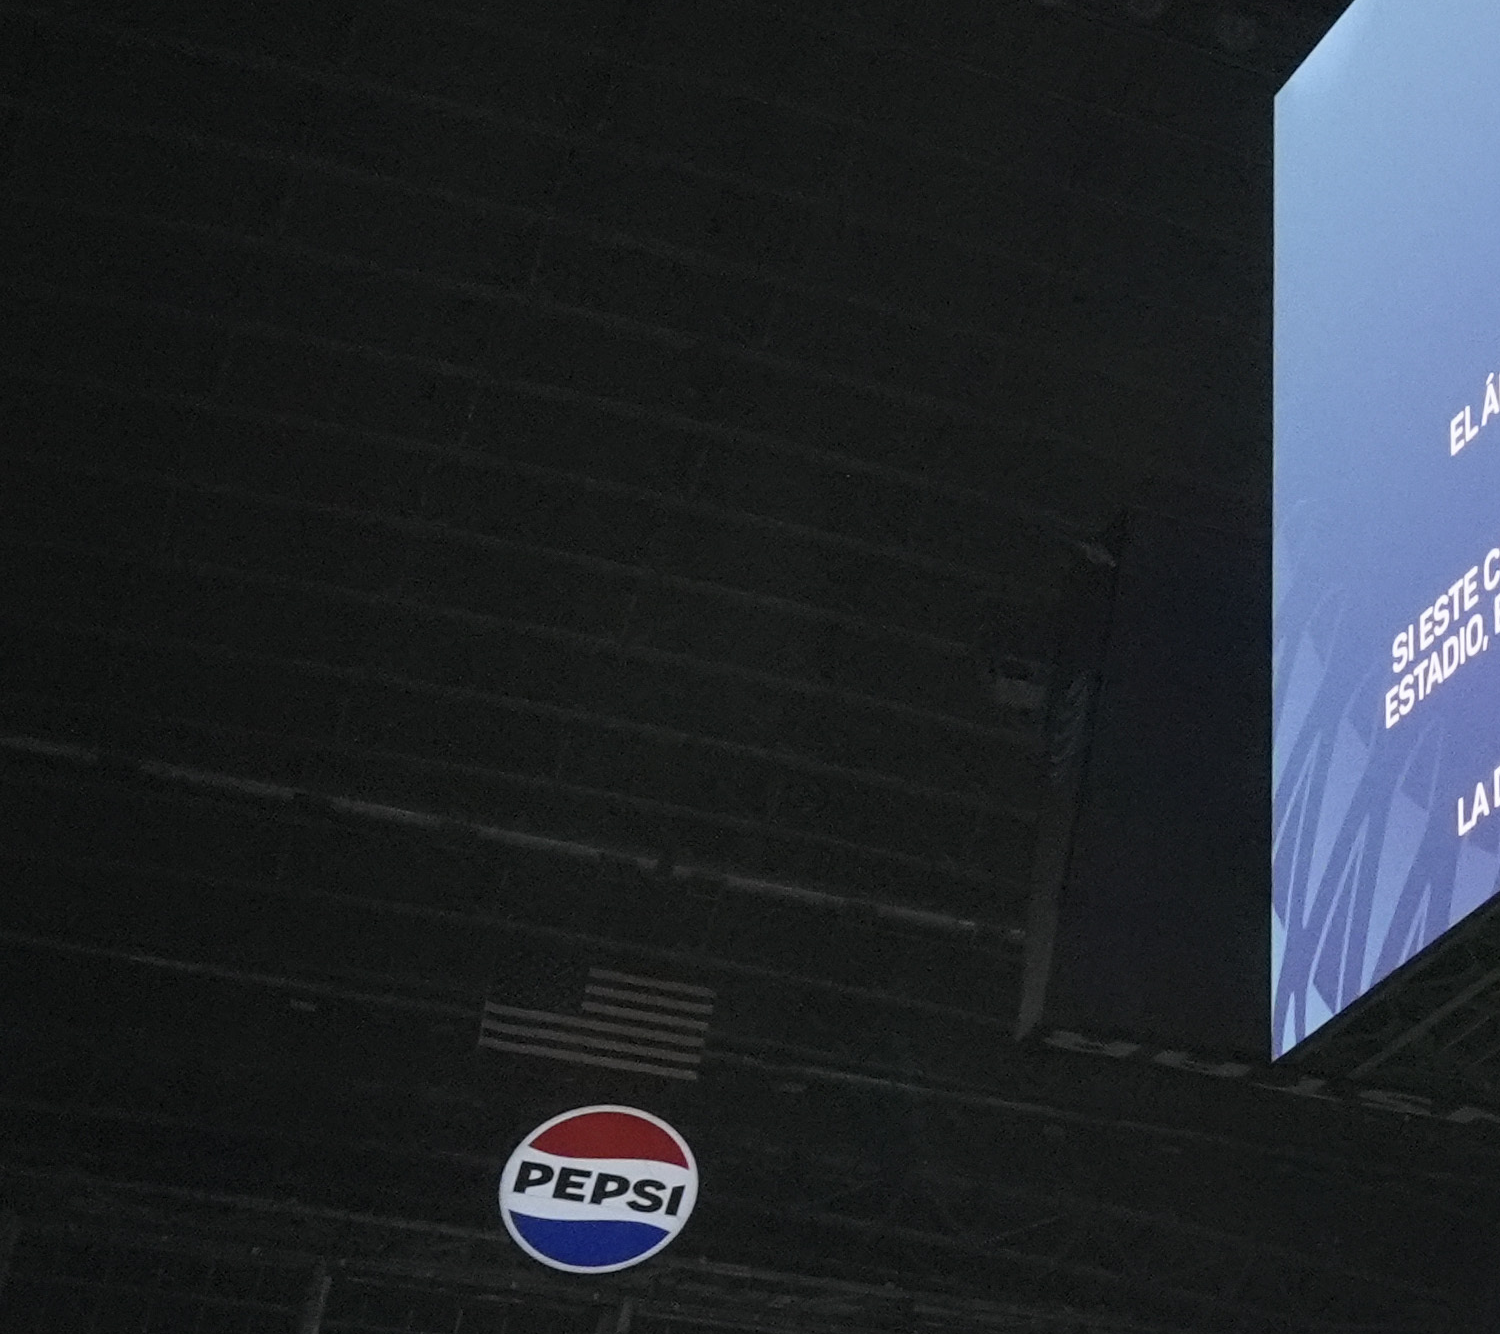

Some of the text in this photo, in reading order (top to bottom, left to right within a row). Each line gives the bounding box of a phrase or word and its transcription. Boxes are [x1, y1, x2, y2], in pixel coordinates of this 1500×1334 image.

[1450, 405, 1479, 456] EL
[1392, 624, 1414, 673] SI
[1419, 565, 1479, 651] ESTE
[1385, 613, 1489, 729] ESTADIO,
[1457, 782, 1490, 837] LA
[513, 1161, 686, 1216] PEPSI
